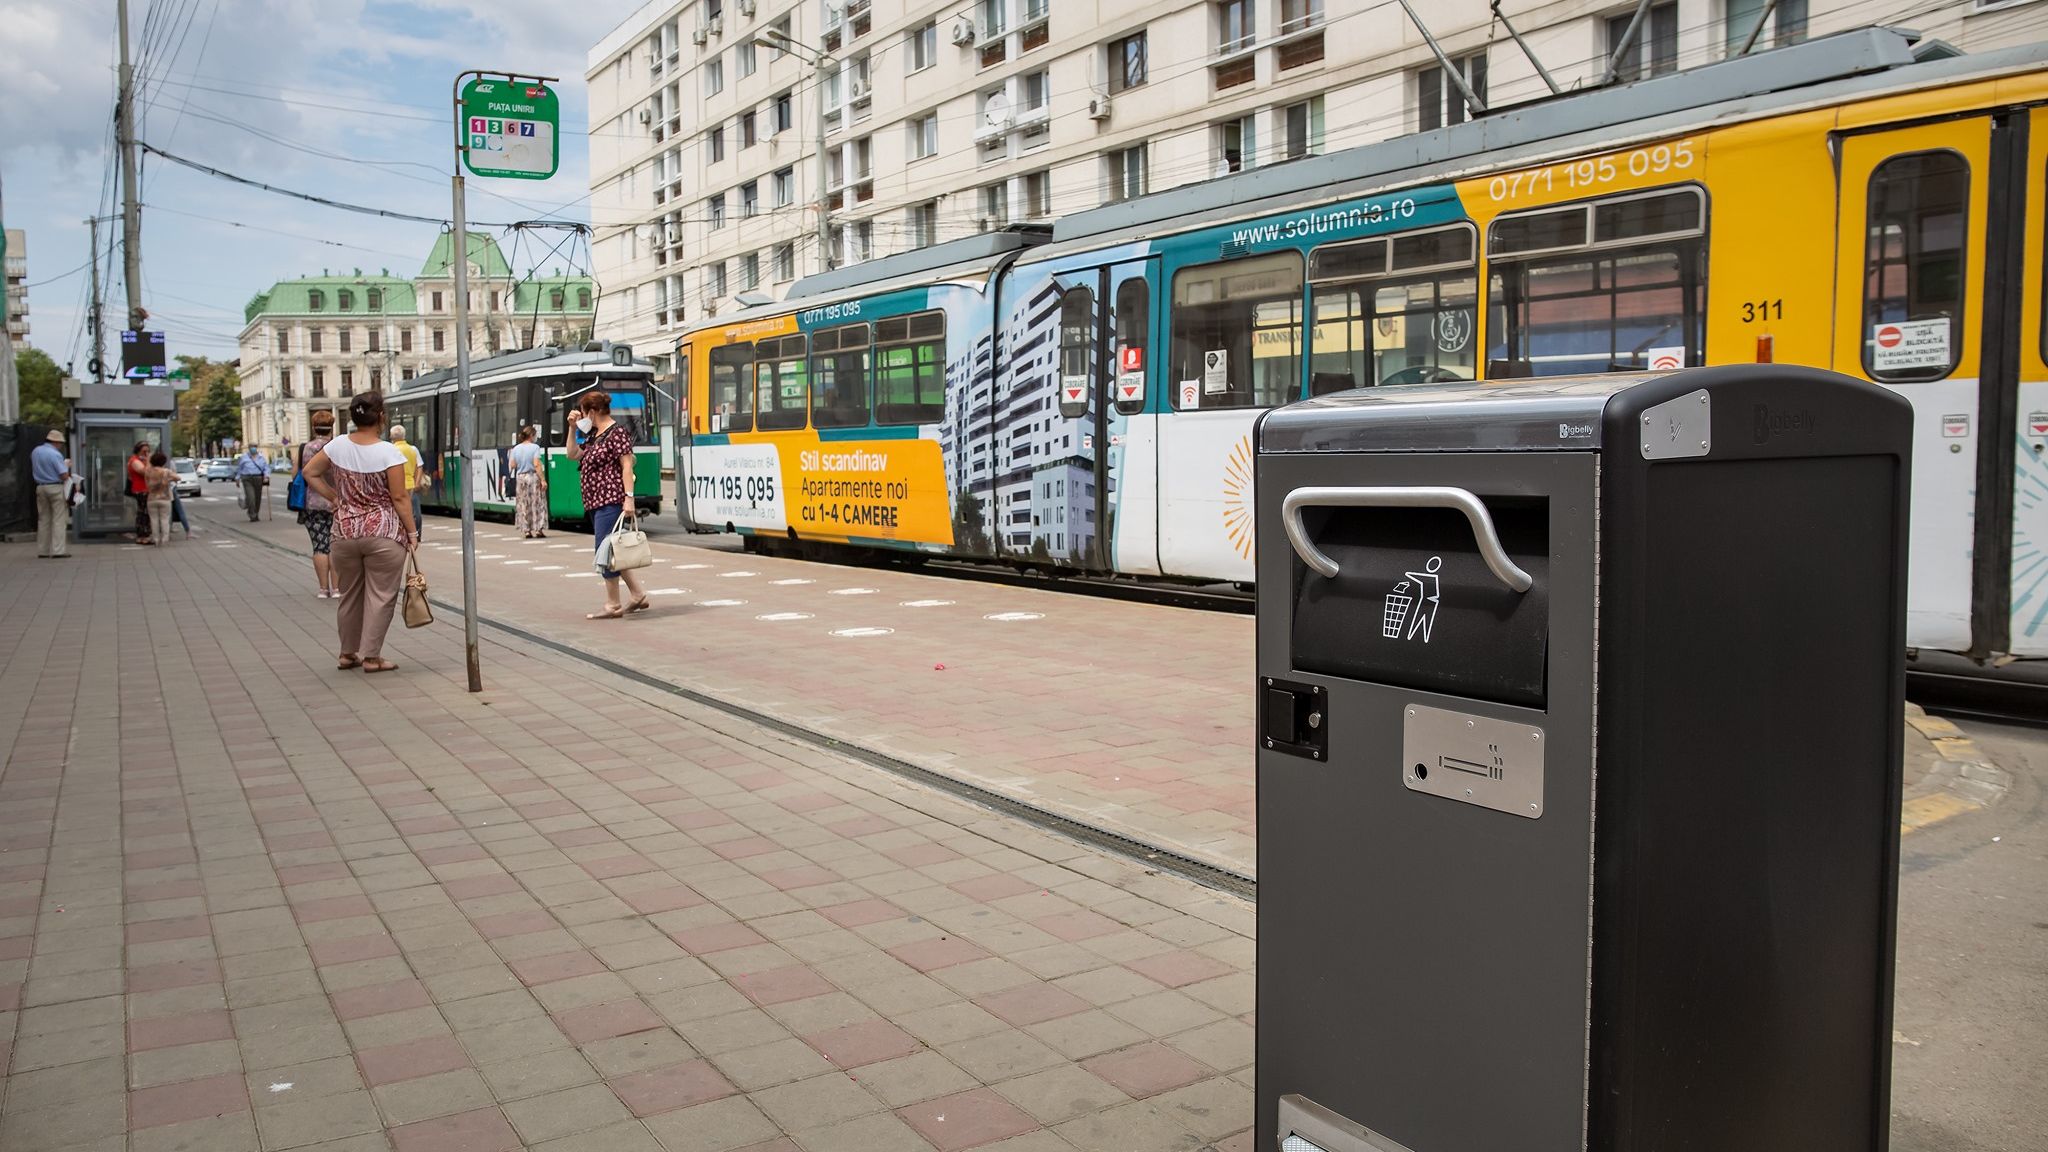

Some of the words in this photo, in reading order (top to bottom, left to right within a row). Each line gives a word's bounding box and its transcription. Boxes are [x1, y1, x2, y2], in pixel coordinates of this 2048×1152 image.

[512, 104, 535, 113] UNIRII
[475, 121, 481, 132] 1
[491, 122, 499, 132] 3
[508, 123, 515, 133] 6
[524, 124, 532, 135] 7
[475, 137, 483, 147] 9
[1489, 169, 1552, 201] 0771
[1564, 156, 1617, 187] 195
[1628, 140, 1694, 177] 095
[1233, 198, 1415, 247] www.solumnia.ro
[804, 310, 824, 324] 0771
[825, 305, 841, 319] 195
[842, 301, 861, 316] 095
[1742, 299, 1783, 323] 311
[617, 350, 625, 364] 7
[1560, 423, 1593, 438] Bigbelly
[1753, 403, 1816, 445] Bigbelly
[800, 450, 819, 471] Stil
[822, 449, 888, 472] scandinav
[689, 475, 716, 499] 0771
[720, 476, 742, 500] 195
[747, 476, 775, 501] 095
[802, 477, 882, 501] Apartamente
[887, 477, 908, 499] noi
[802, 505, 815, 521] cu
[819, 503, 839, 522] 1-4
[843, 504, 898, 527] CAMERE
